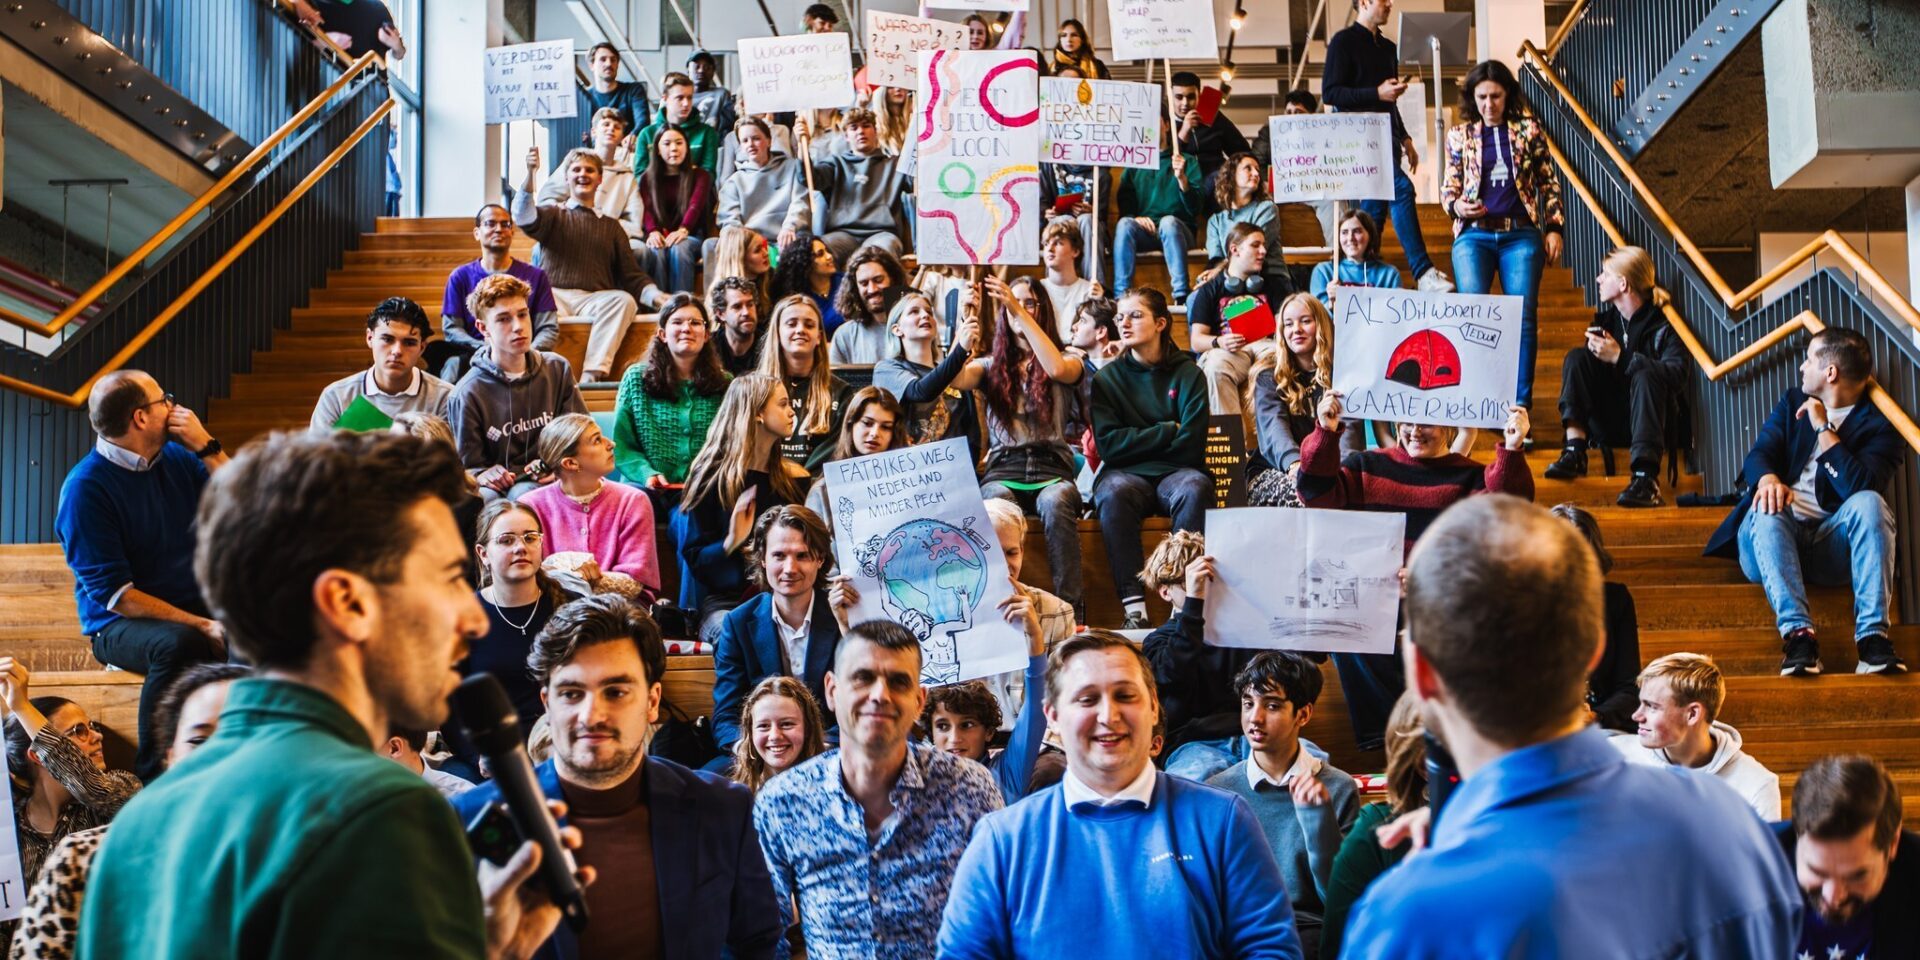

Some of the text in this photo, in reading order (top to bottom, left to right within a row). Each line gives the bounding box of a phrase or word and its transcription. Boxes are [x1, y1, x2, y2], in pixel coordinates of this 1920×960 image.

[488, 47, 563, 66] VERDEDIG
[755, 79, 779, 94] HET
[500, 95, 571, 117] KANT
[1044, 103, 1123, 124] LERAREN
[1046, 122, 1121, 142] INVESTEER
[951, 137, 1011, 157] LOON
[1052, 142, 1156, 165] DE TOEKOMST
[502, 411, 554, 437] Columbi
[1205, 445, 1231, 453] EREN
[839, 446, 955, 483] FATBIKES WEG
[866, 471, 943, 500] NEDERLAND
[1216, 489, 1229, 497] ET
[868, 492, 946, 519] MINDER PECH
